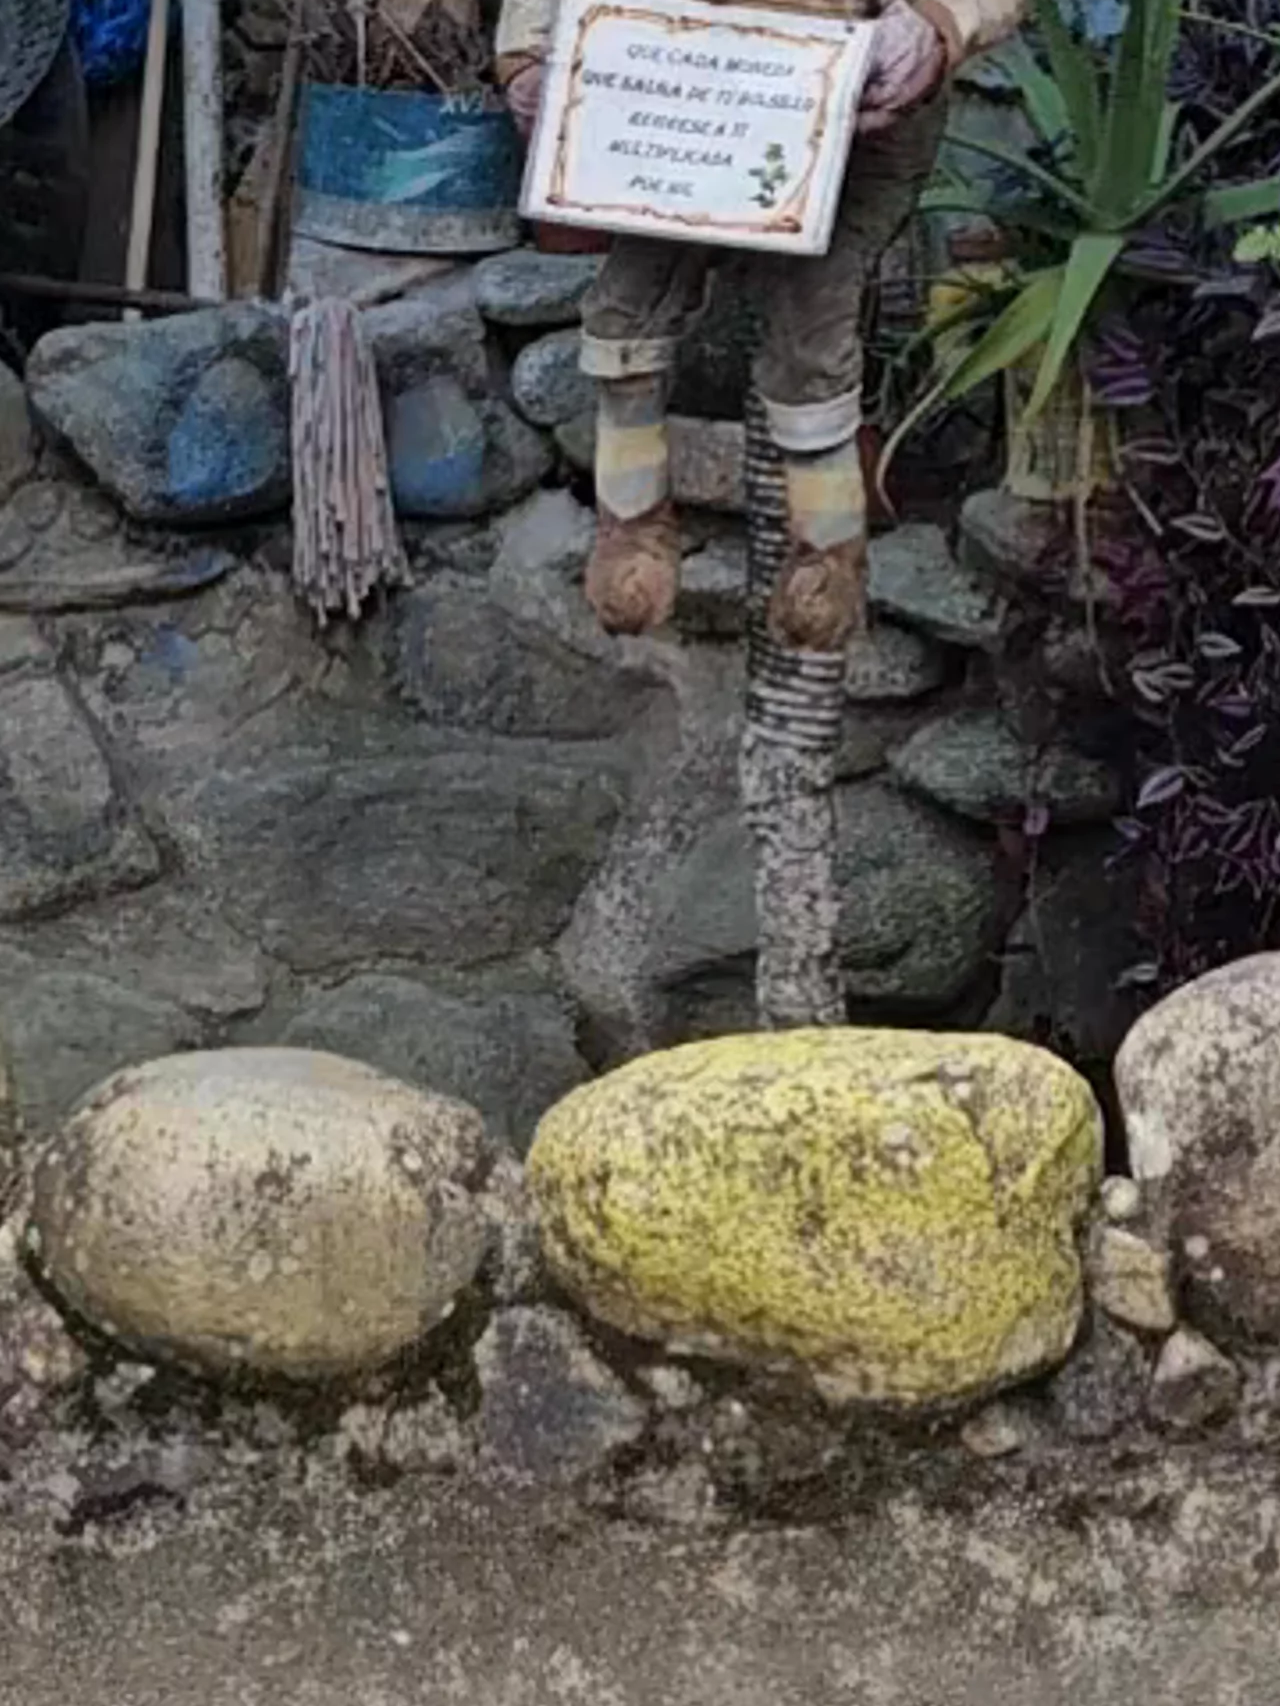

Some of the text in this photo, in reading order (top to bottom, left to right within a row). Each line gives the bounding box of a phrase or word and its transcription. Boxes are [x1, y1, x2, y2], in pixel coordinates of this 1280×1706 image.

[626, 43, 663, 64] QUE
[666, 47, 719, 72] CADA
[581, 68, 619, 88] QUE
[686, 86, 711, 104] DE
